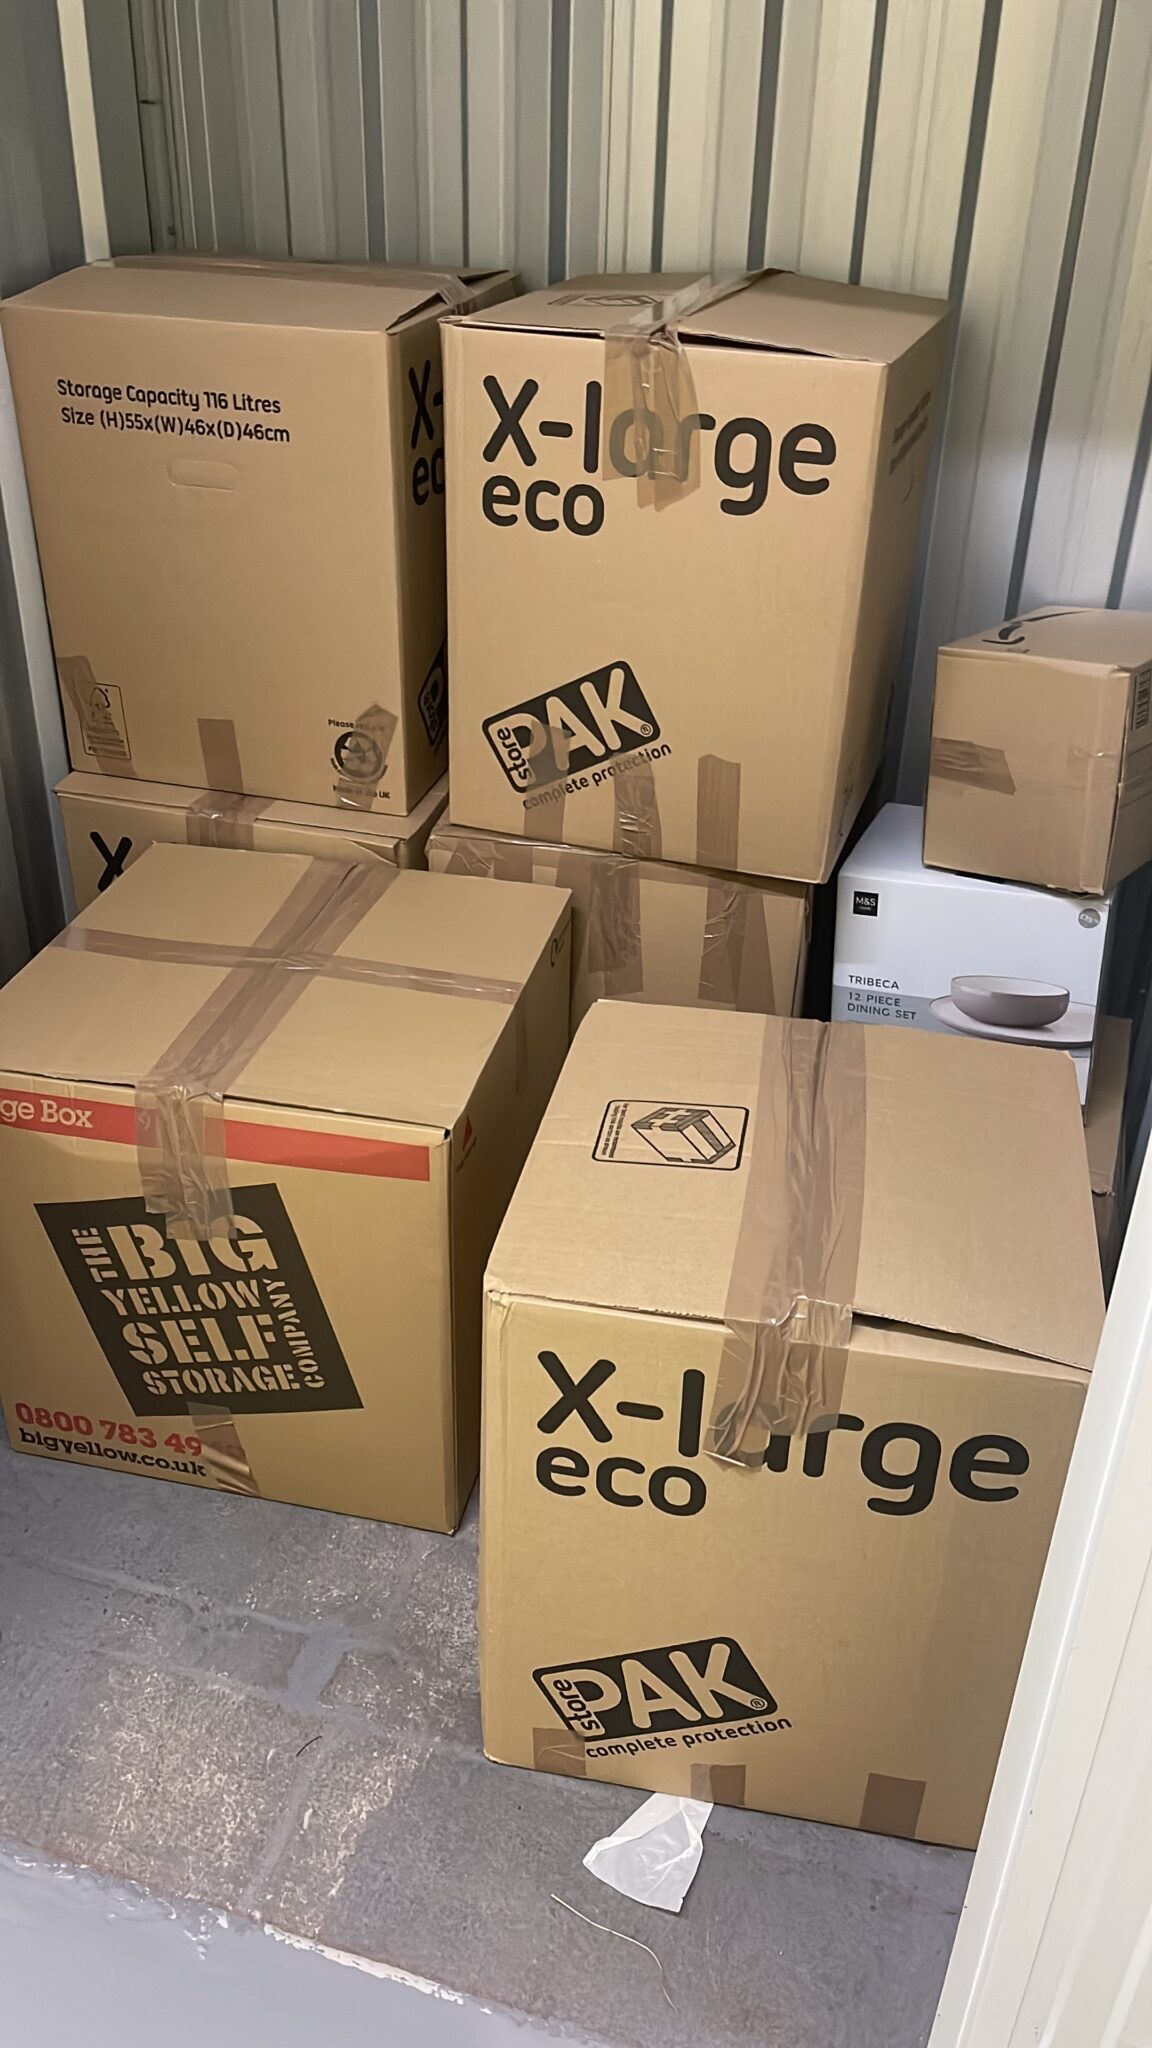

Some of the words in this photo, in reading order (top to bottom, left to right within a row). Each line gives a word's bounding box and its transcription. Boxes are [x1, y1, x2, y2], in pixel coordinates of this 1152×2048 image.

[57, 379, 122, 404] Storage
[126, 385, 199, 411] Capacity
[204, 391, 228, 409] 116
[233, 394, 281, 413] Litres
[61, 407, 95, 425] Size
[100, 412, 290, 442] (H)55x(W)46x(D)46cm
[482, 375, 838, 516] X-large
[482, 475, 605, 537] eco
[328, 719, 354, 729] Please
[497, 727, 532, 781] store
[522, 776, 589, 810] complete
[591, 743, 672, 786] protection
[855, 896, 877, 907] M&S
[848, 974, 899, 990] TRIBECA
[849, 992, 861, 1002] 12
[866, 994, 901, 1007] PIECE
[847, 1003, 890, 1017] DINING
[895, 1009, 917, 1020] SET
[40, 1099, 94, 1128] Box
[71, 1227, 119, 1283] THE
[106, 1214, 279, 1280] BIG
[101, 1278, 261, 1316] YELLOW
[122, 1314, 277, 1365] SELF
[262, 1277, 326, 1389] COMPANY
[142, 1363, 301, 1395] STORAGE
[15, 1402, 94, 1436] 0800
[99, 1419, 157, 1448] 783
[537, 1350, 1030, 1516] X-large
[19, 1427, 207, 1477] bigyellow.co.uk
[536, 1446, 707, 1517] eco
[553, 1679, 600, 1732] store
[586, 1736, 678, 1758] complete
[682, 1718, 793, 1748] protection
